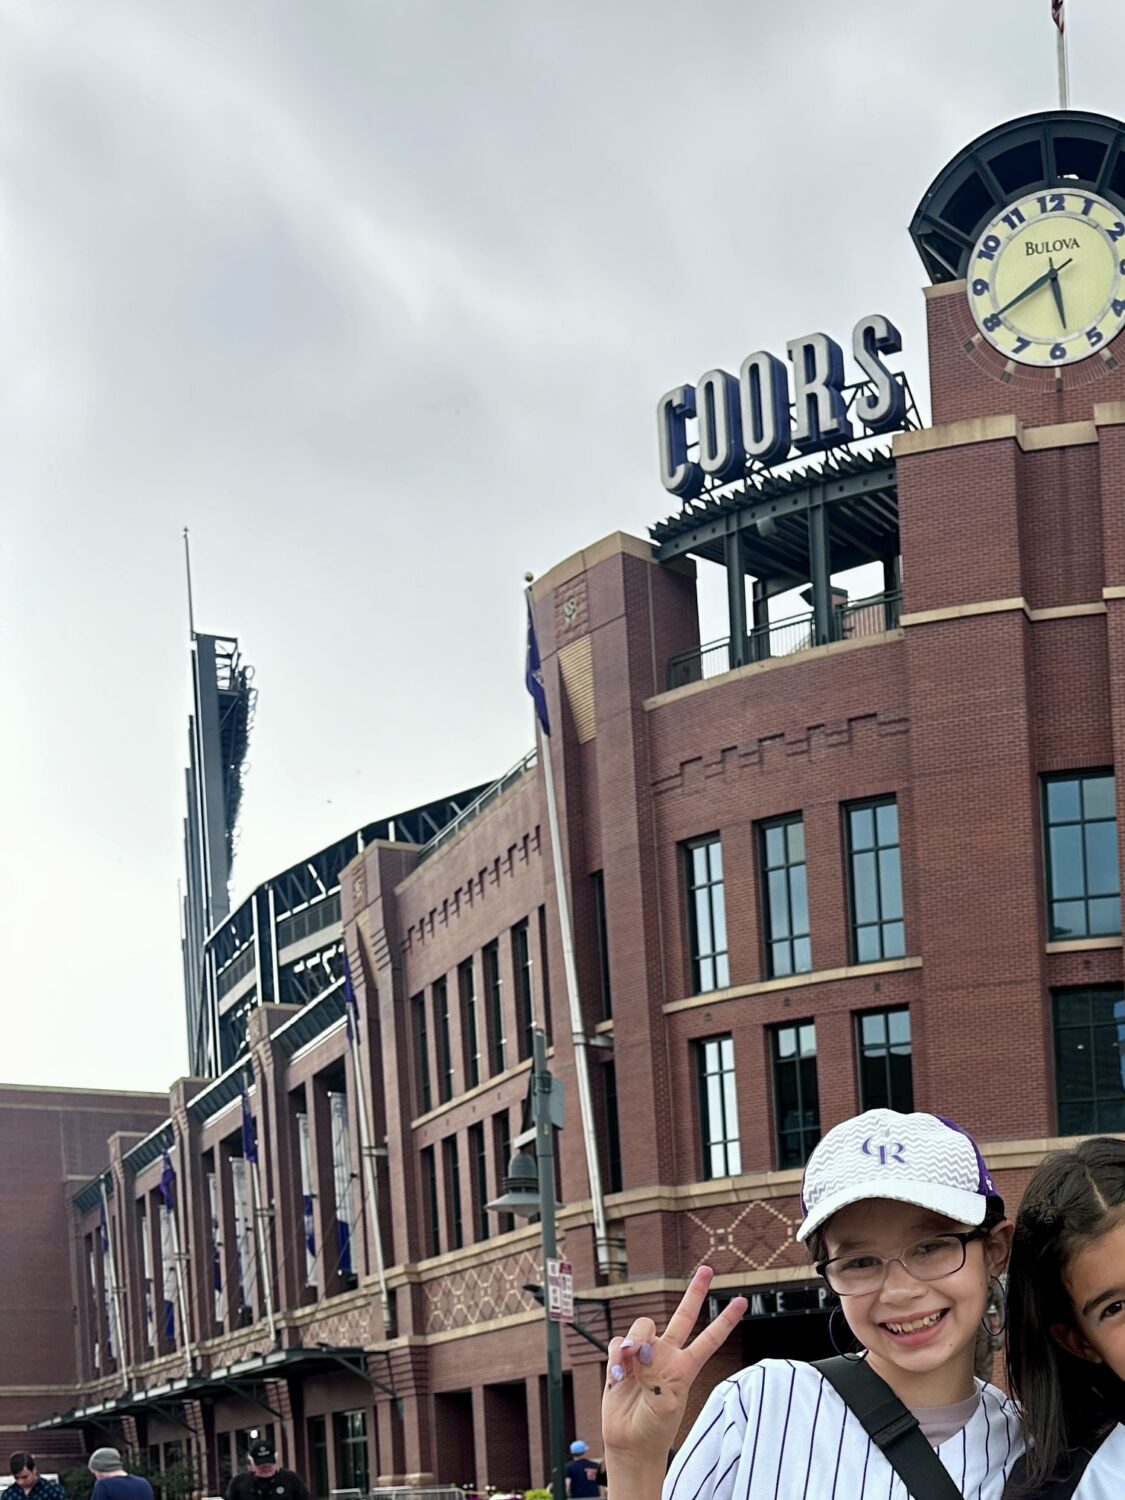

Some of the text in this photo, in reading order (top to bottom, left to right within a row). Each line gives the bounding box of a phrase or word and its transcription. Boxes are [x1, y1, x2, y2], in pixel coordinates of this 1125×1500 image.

[1037, 194, 1065, 213] 12
[1082, 199, 1096, 215] 1
[1001, 208, 1026, 230] 11
[1105, 222, 1125, 242] 2
[977, 235, 1001, 261] 10
[1025, 238, 1080, 256] BULOVA
[972, 278, 990, 296] 9
[983, 314, 1001, 332] 8
[1011, 336, 1031, 354] 7
[1085, 327, 1103, 347] 5
[1050, 343, 1066, 360] 6
[657, 314, 906, 497] COORS
[862, 1134, 906, 1165] CR
[709, 1291, 785, 1320] HME
